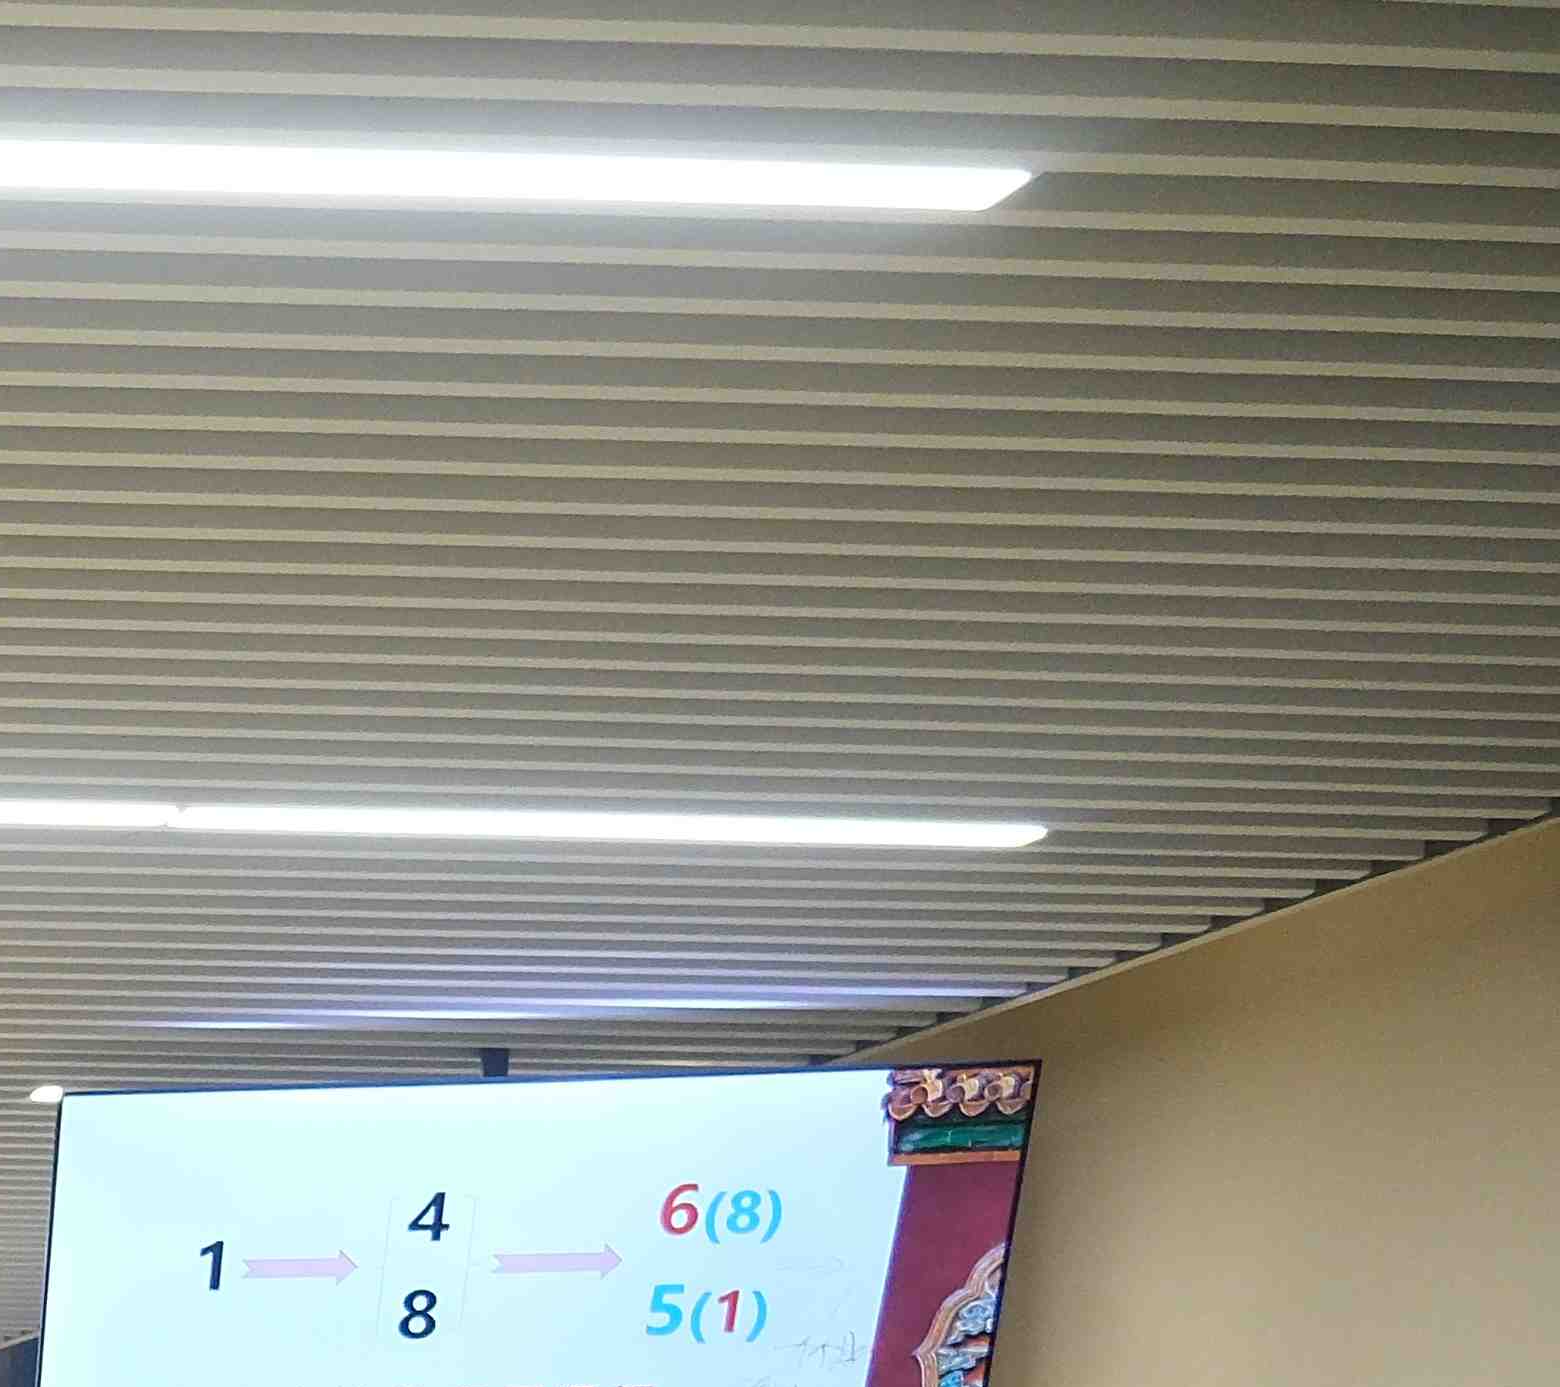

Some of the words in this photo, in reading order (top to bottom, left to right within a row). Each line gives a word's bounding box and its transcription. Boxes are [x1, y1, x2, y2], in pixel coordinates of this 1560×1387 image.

[407, 1191, 451, 1242] 4
[660, 1183, 783, 1244] 6(8)
[199, 1240, 226, 1291] 1
[397, 1289, 438, 1340] 8
[645, 1283, 768, 1343] 5(1)
